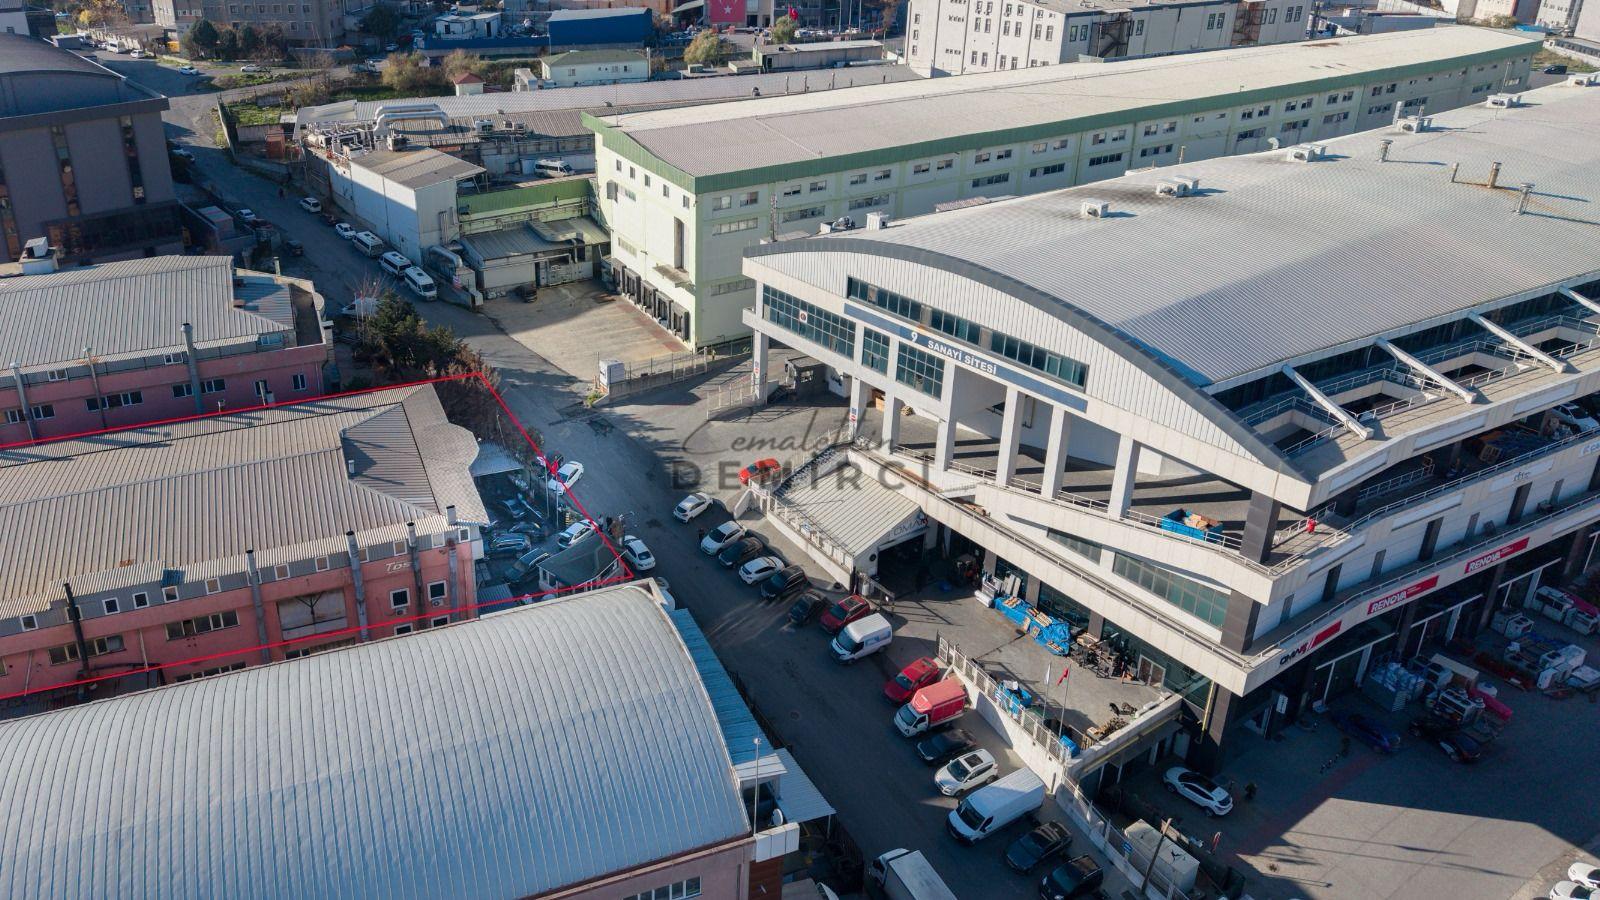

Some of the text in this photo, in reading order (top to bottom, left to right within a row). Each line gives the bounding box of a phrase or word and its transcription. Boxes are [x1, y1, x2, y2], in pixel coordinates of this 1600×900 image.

[928, 340, 962, 360] SANAYİ
[964, 355, 997, 375] SİTESİ
[1371, 590, 1407, 613] RENOVA
